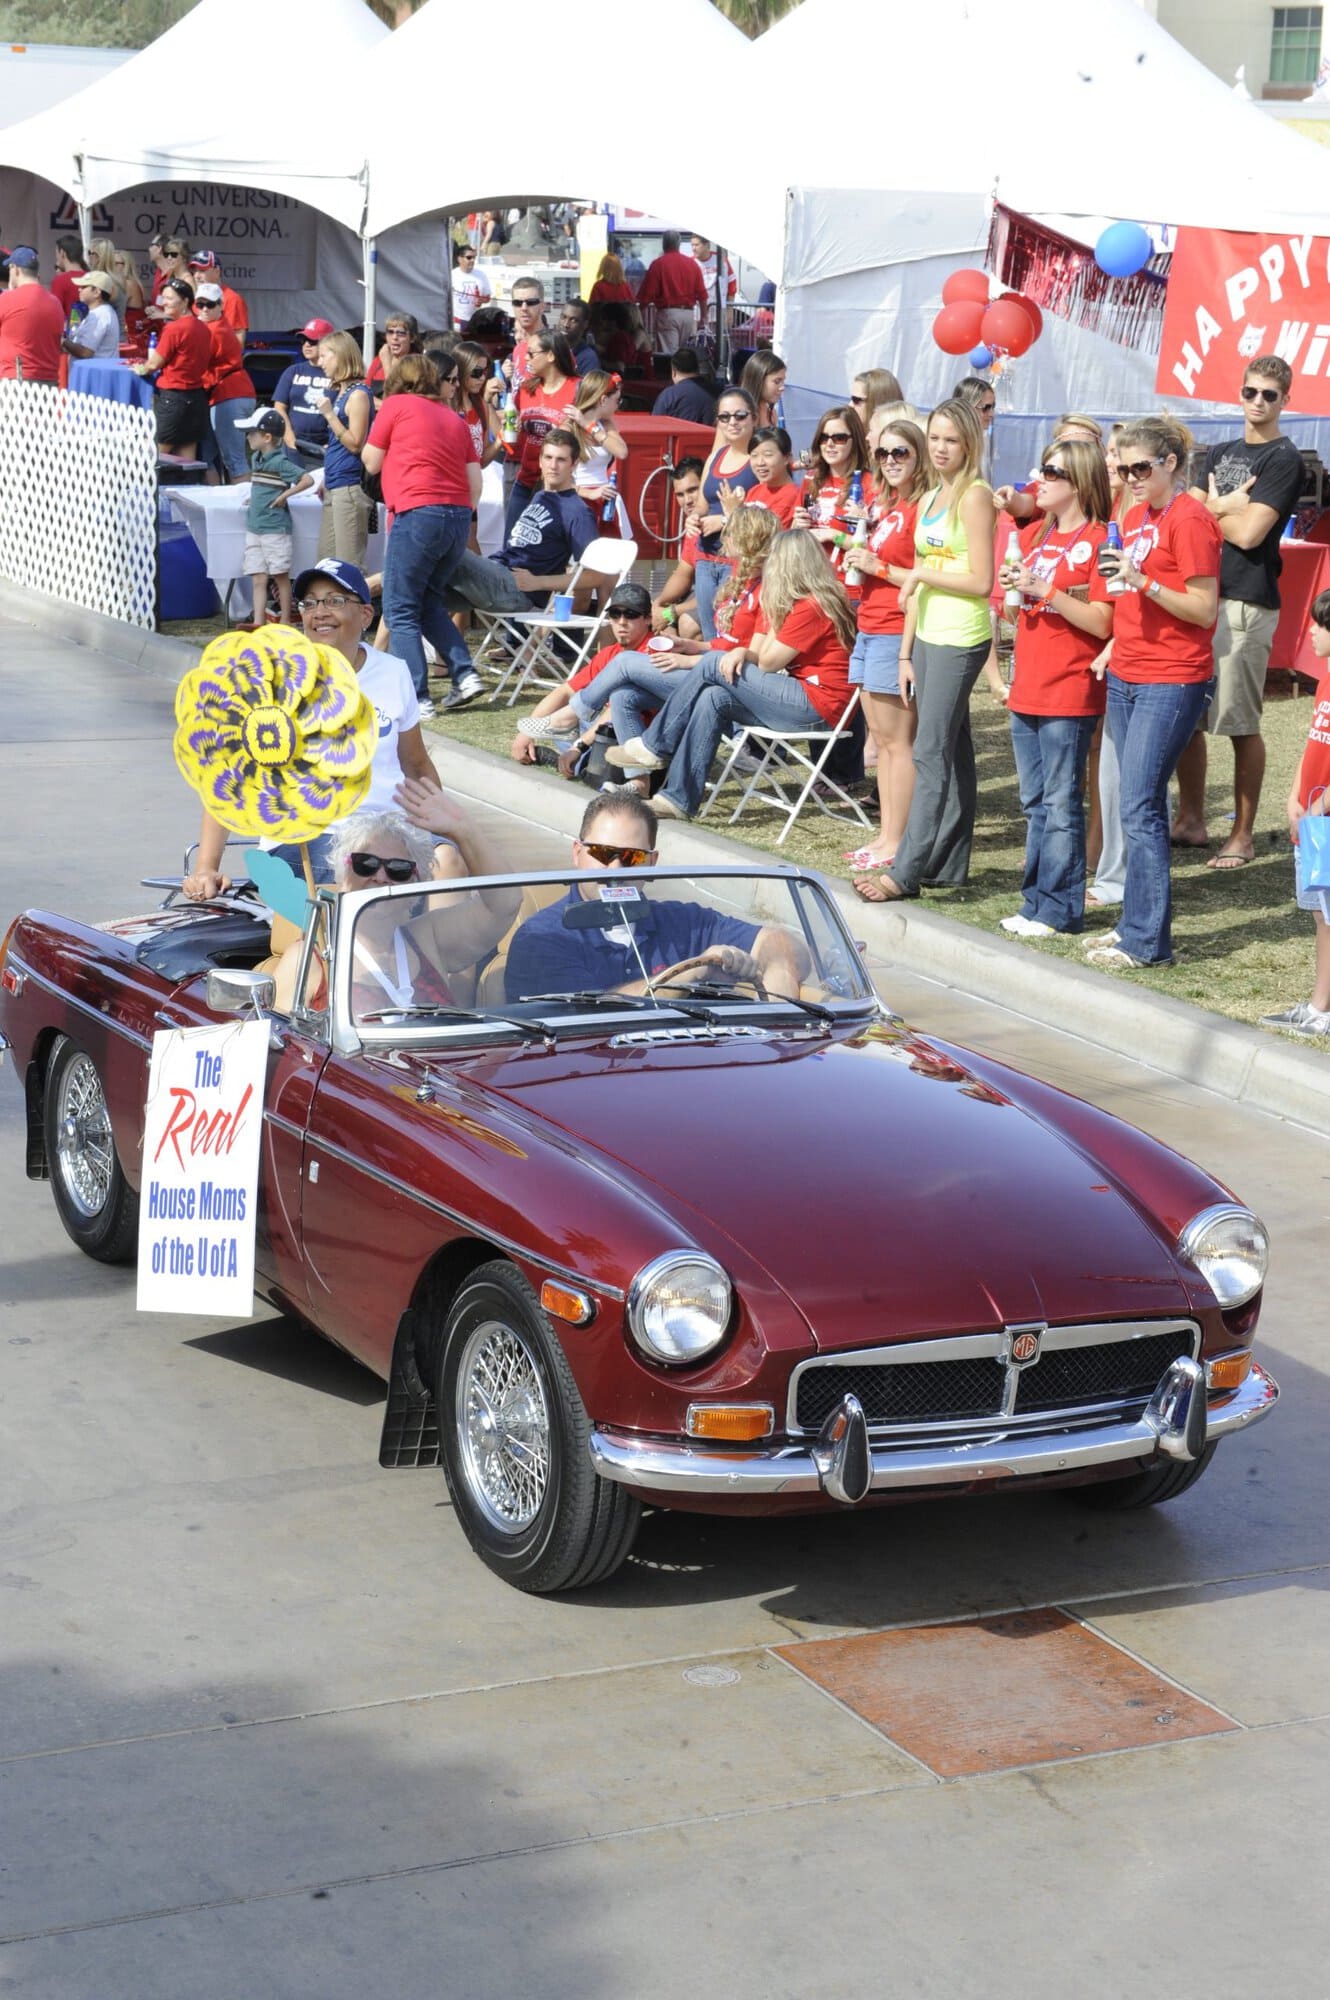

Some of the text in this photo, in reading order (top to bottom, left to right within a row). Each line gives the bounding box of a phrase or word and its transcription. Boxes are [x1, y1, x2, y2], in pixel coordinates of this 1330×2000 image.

[171, 185, 300, 208] UNIVERSI
[135, 212, 283, 239] OF ARIZONA
[1172, 234, 1313, 396] HAPPY
[1273, 319, 1330, 377] Wi
[195, 1050, 222, 1088] The
[154, 1083, 254, 1173] Real
[149, 1181, 246, 1221] House Moms
[152, 1236, 238, 1278] of the U of A
[1015, 1336, 1035, 1357] MG
